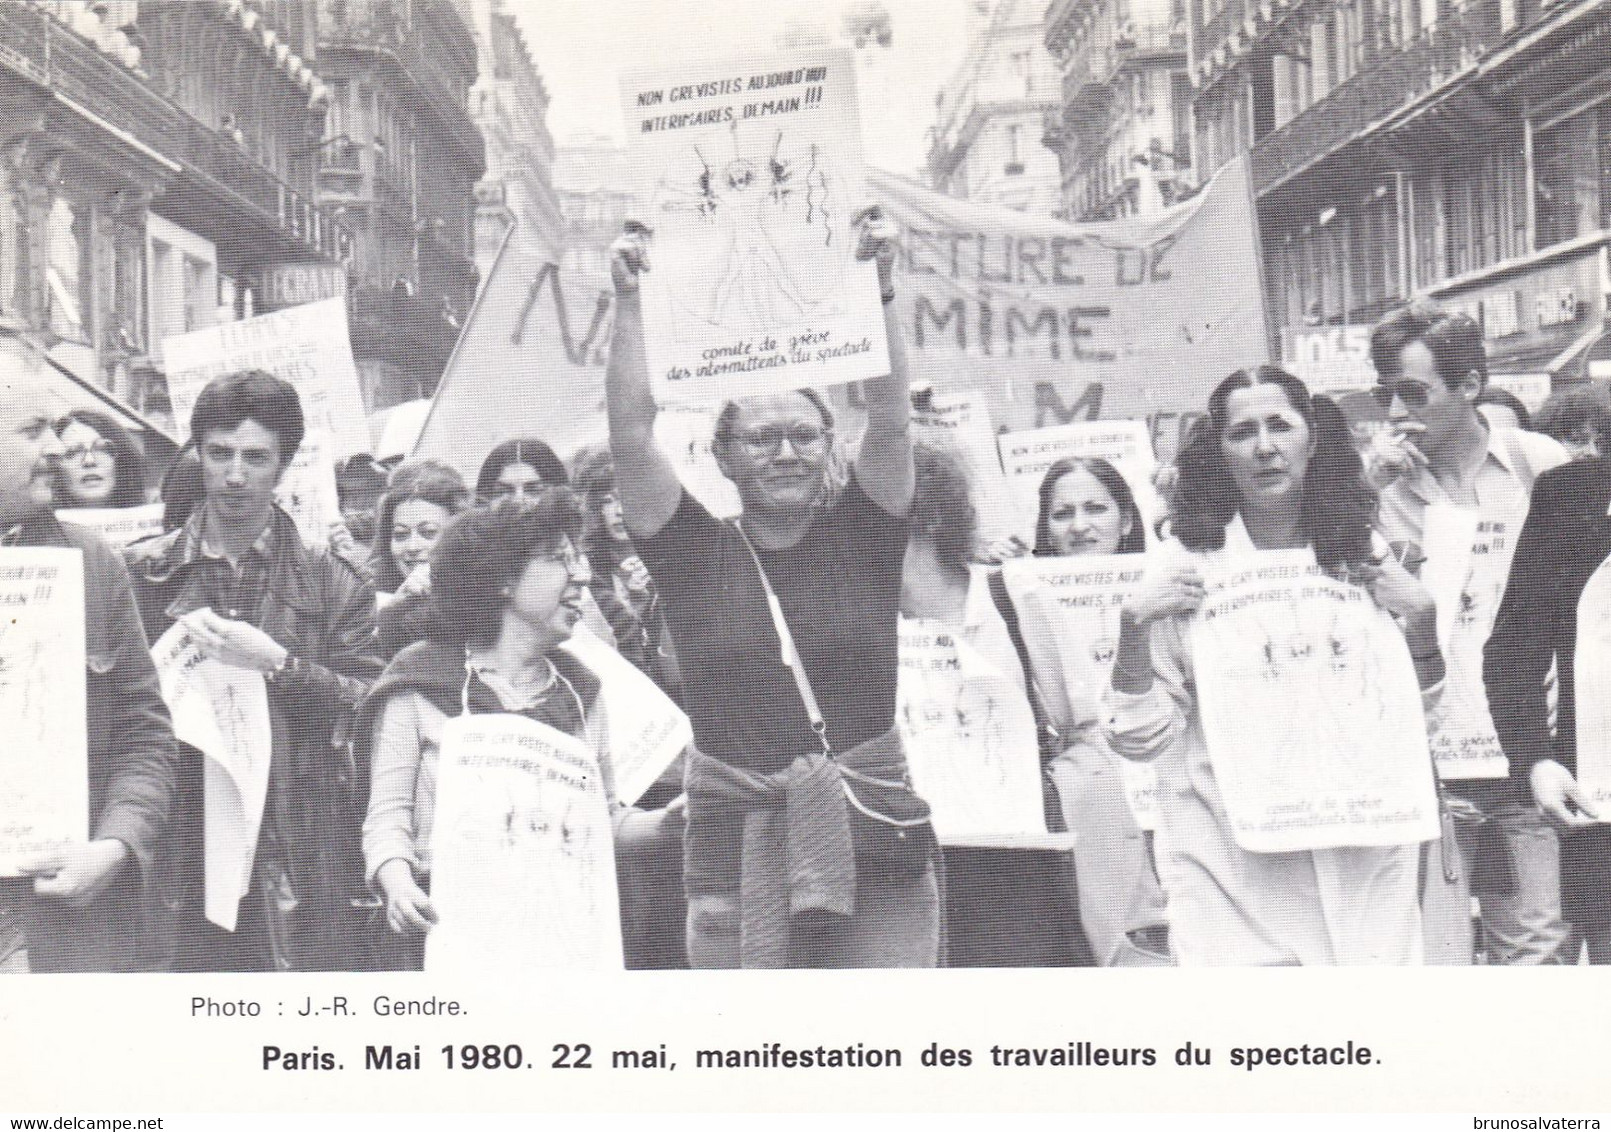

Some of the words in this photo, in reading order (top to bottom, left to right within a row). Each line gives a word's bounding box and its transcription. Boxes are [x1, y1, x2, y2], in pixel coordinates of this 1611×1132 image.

[637, 87, 663, 106] NON
[669, 77, 742, 103] GREVISTES
[747, 67, 827, 91] AUJOURD'HUI
[743, 98, 801, 120] DEMAIN
[702, 337, 754, 360] comité
[759, 336, 777, 353] de
[789, 328, 830, 355] grève
[914, 290, 1117, 362] MIME
[667, 366, 692, 381] des
[696, 354, 788, 378] intermittents
[791, 350, 811, 365] du
[816, 337, 872, 364] spectacle
